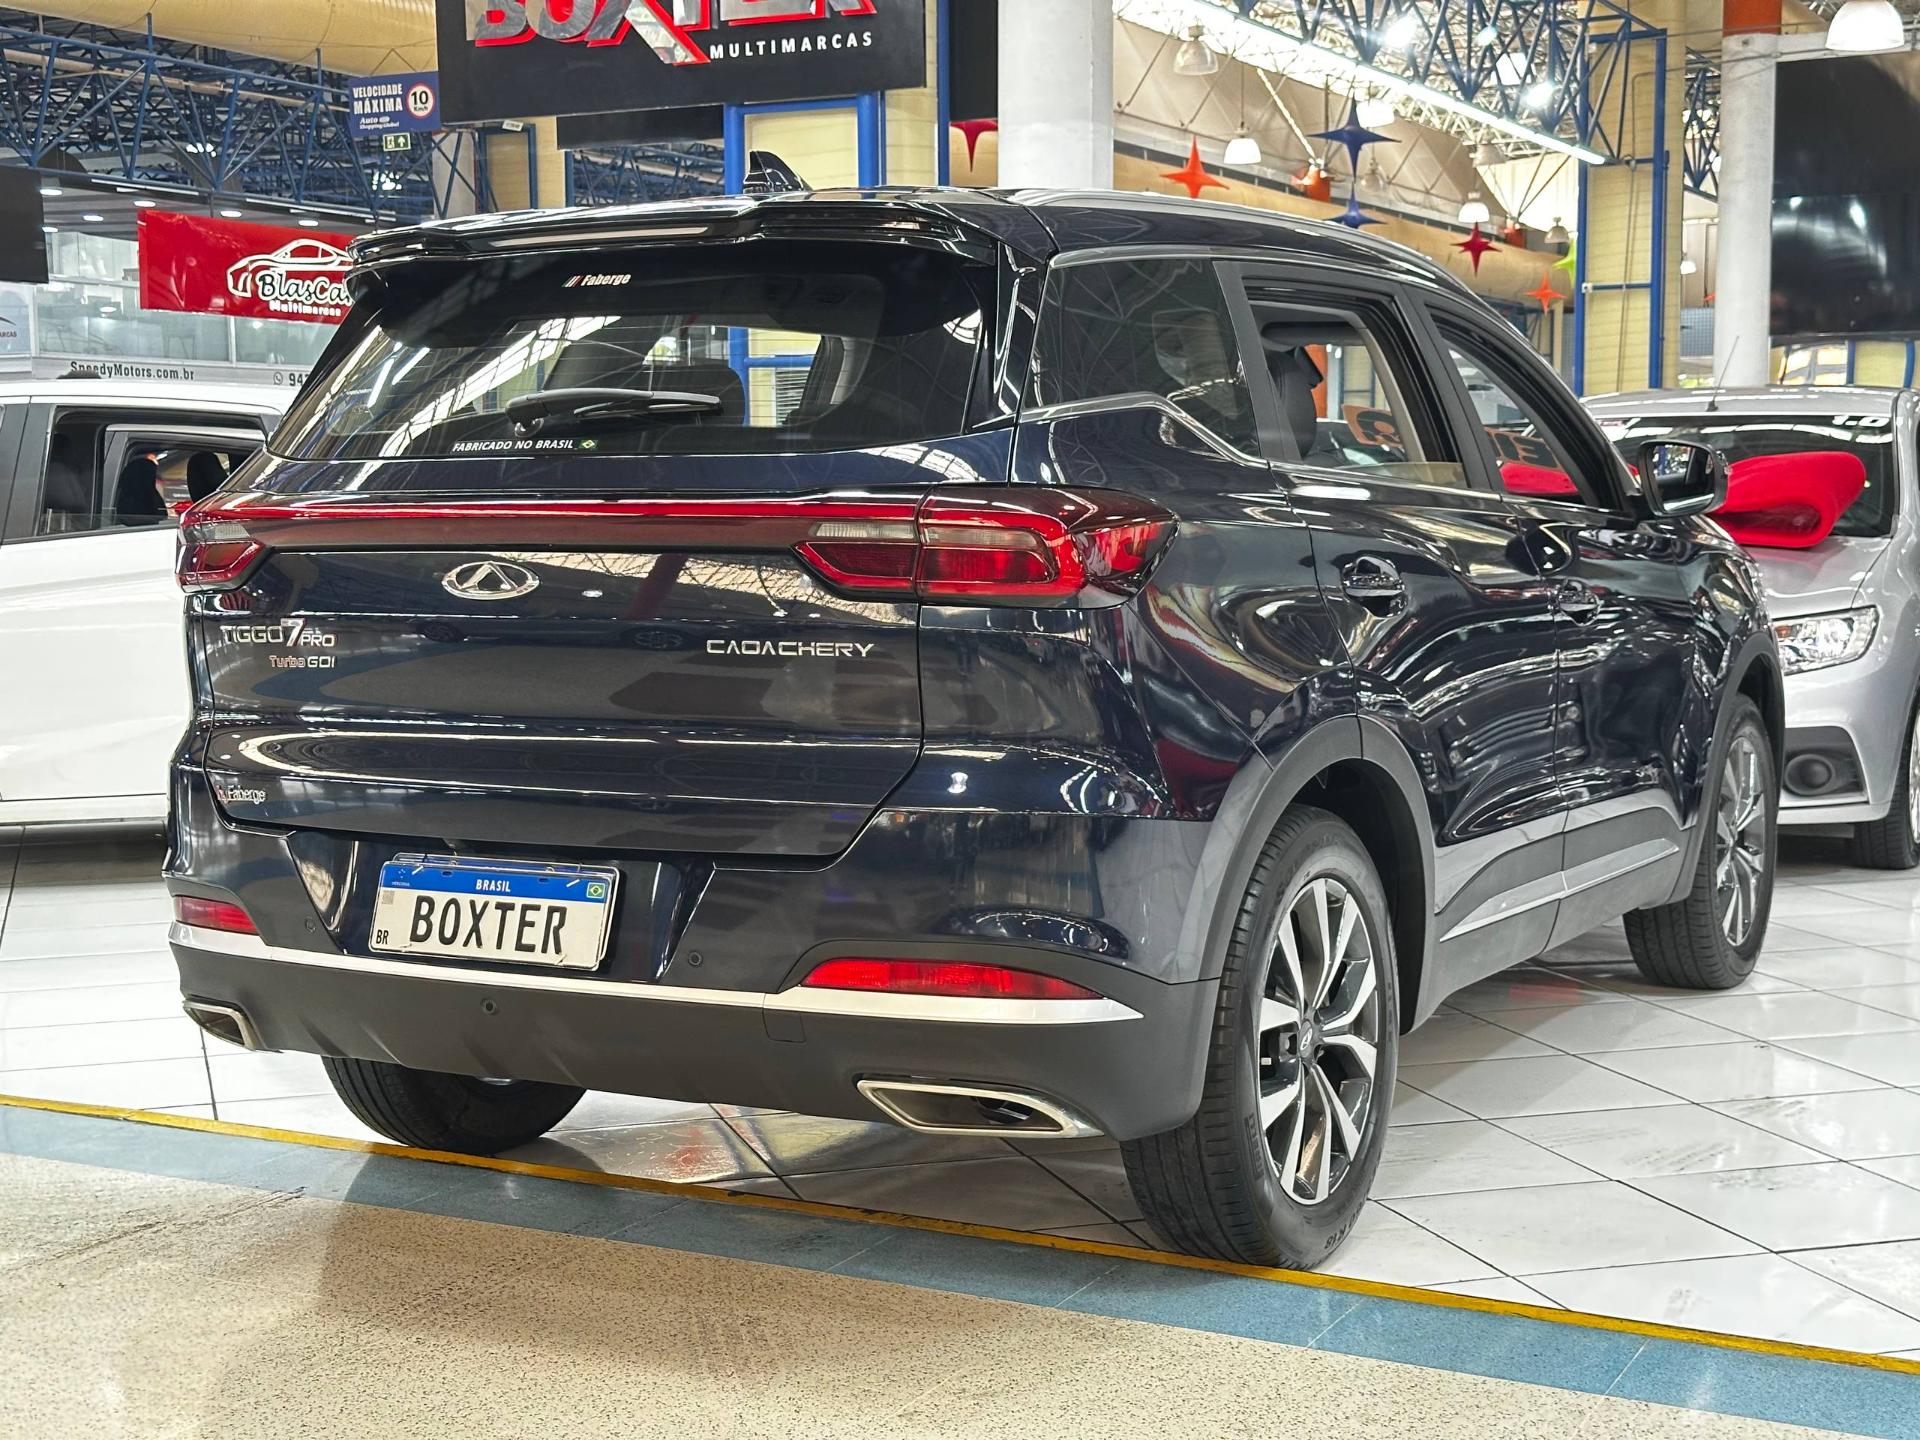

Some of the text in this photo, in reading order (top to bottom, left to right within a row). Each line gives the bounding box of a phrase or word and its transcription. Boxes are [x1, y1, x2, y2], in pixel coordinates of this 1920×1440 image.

[709, 31, 873, 60] MULTIMARCAS
[352, 83, 403, 99] VELOCIDADE
[411, 90, 429, 106] 10
[353, 97, 403, 115] MÁXIMA
[256, 269, 353, 306] BlasCa
[580, 273, 632, 287] Faberge
[288, 372, 309, 387] 94
[1832, 414, 1891, 428] 1.0
[452, 439, 575, 452] FABRICADO NO BRASIL
[300, 634, 338, 648] PRO
[706, 639, 875, 658] CAOACHERY
[268, 654, 305, 668] Turbo
[475, 879, 512, 892] BRASIL
[409, 894, 568, 955] BOXTER
[375, 928, 390, 946] BR
